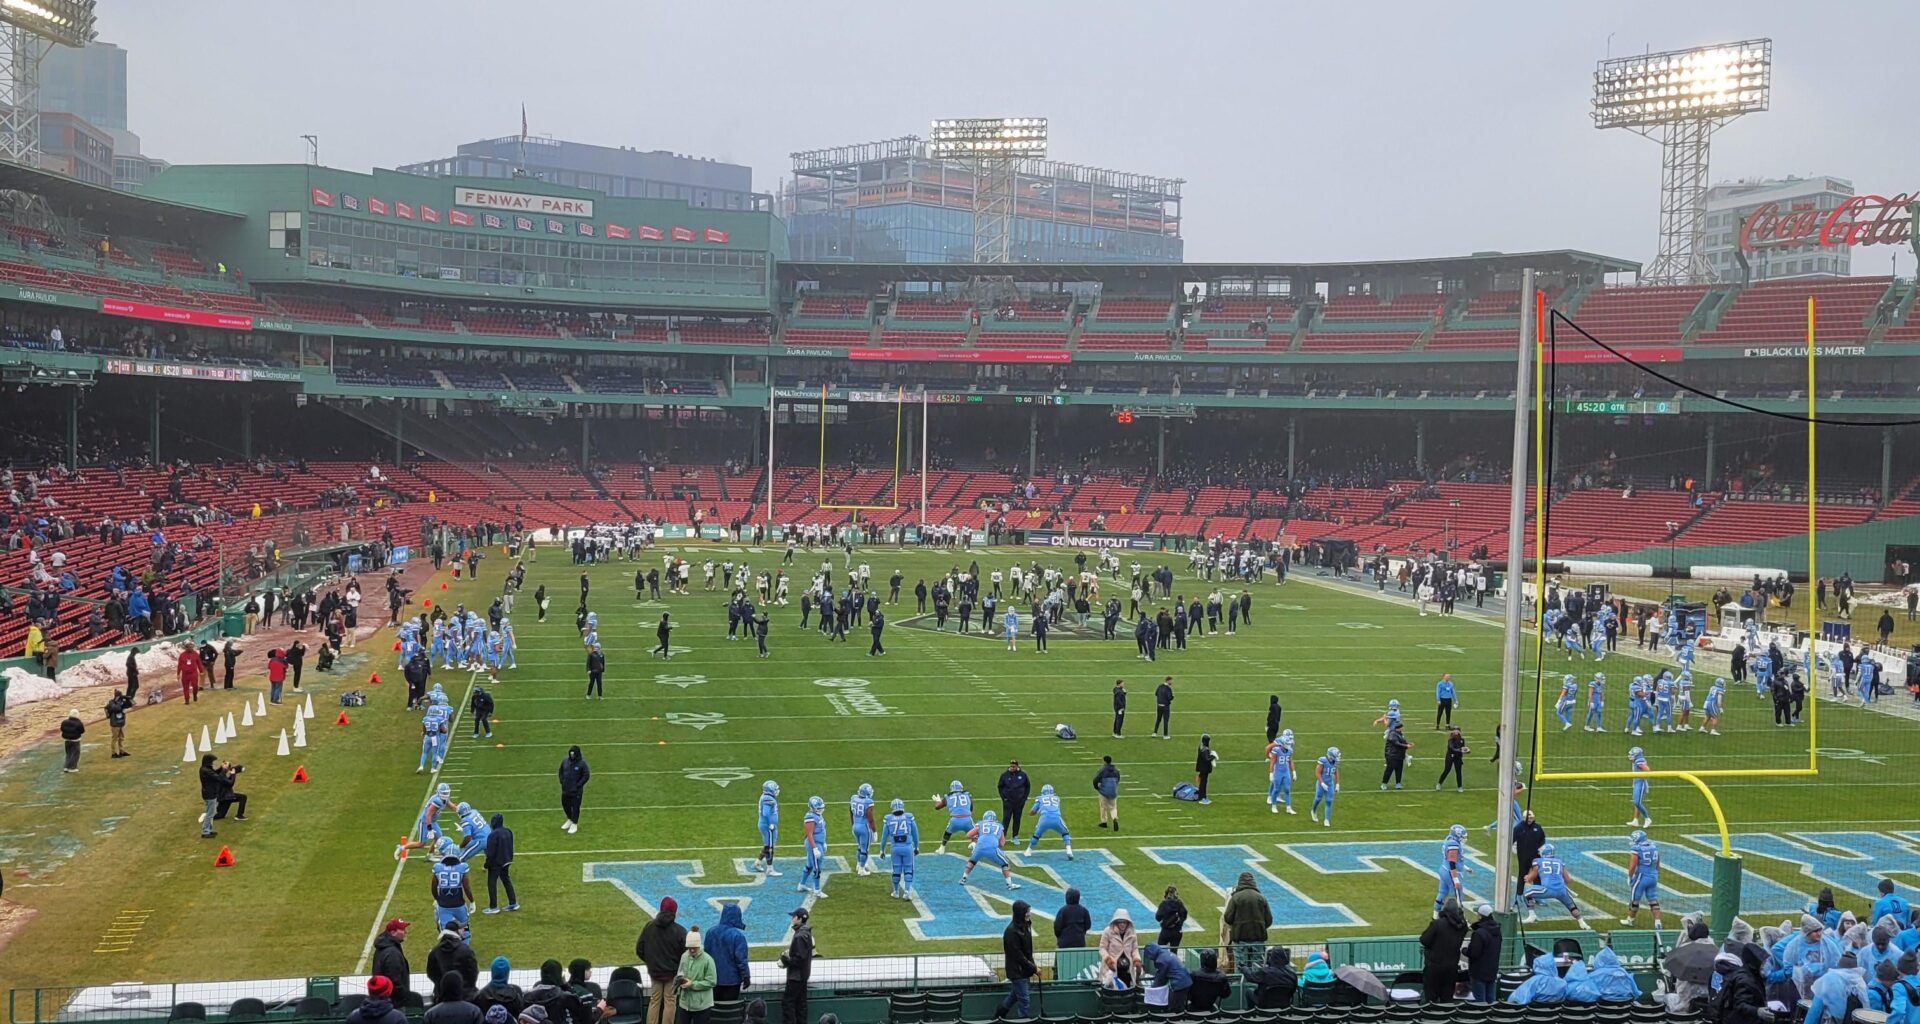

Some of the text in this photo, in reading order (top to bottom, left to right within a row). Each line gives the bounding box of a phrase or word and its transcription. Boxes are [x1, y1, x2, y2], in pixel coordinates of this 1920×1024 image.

[464, 191, 585, 213] FENWAY PARK
[1738, 190, 1918, 252] Coca-Cola
[1154, 353, 1182, 361] PAVILION
[1760, 346, 1866, 357] BLACK LIVES MATTER
[136, 363, 148, 373] BALL
[163, 364, 180, 376] 45:20
[936, 395, 961, 403] 45:20
[1576, 402, 1606, 412] 45:20
[1610, 403, 1625, 411] QTR
[1118, 412, 1133, 423] 25
[1051, 536, 1130, 548] CONNECTICUT
[424, 721, 439, 731] 23
[950, 795, 968, 808] 78
[1042, 795, 1059, 807] 55
[889, 821, 909, 835] 74
[982, 823, 1000, 835] 67
[1642, 851, 1659, 861] 54
[1541, 860, 1561, 875] 57
[438, 871, 461, 887] 69
